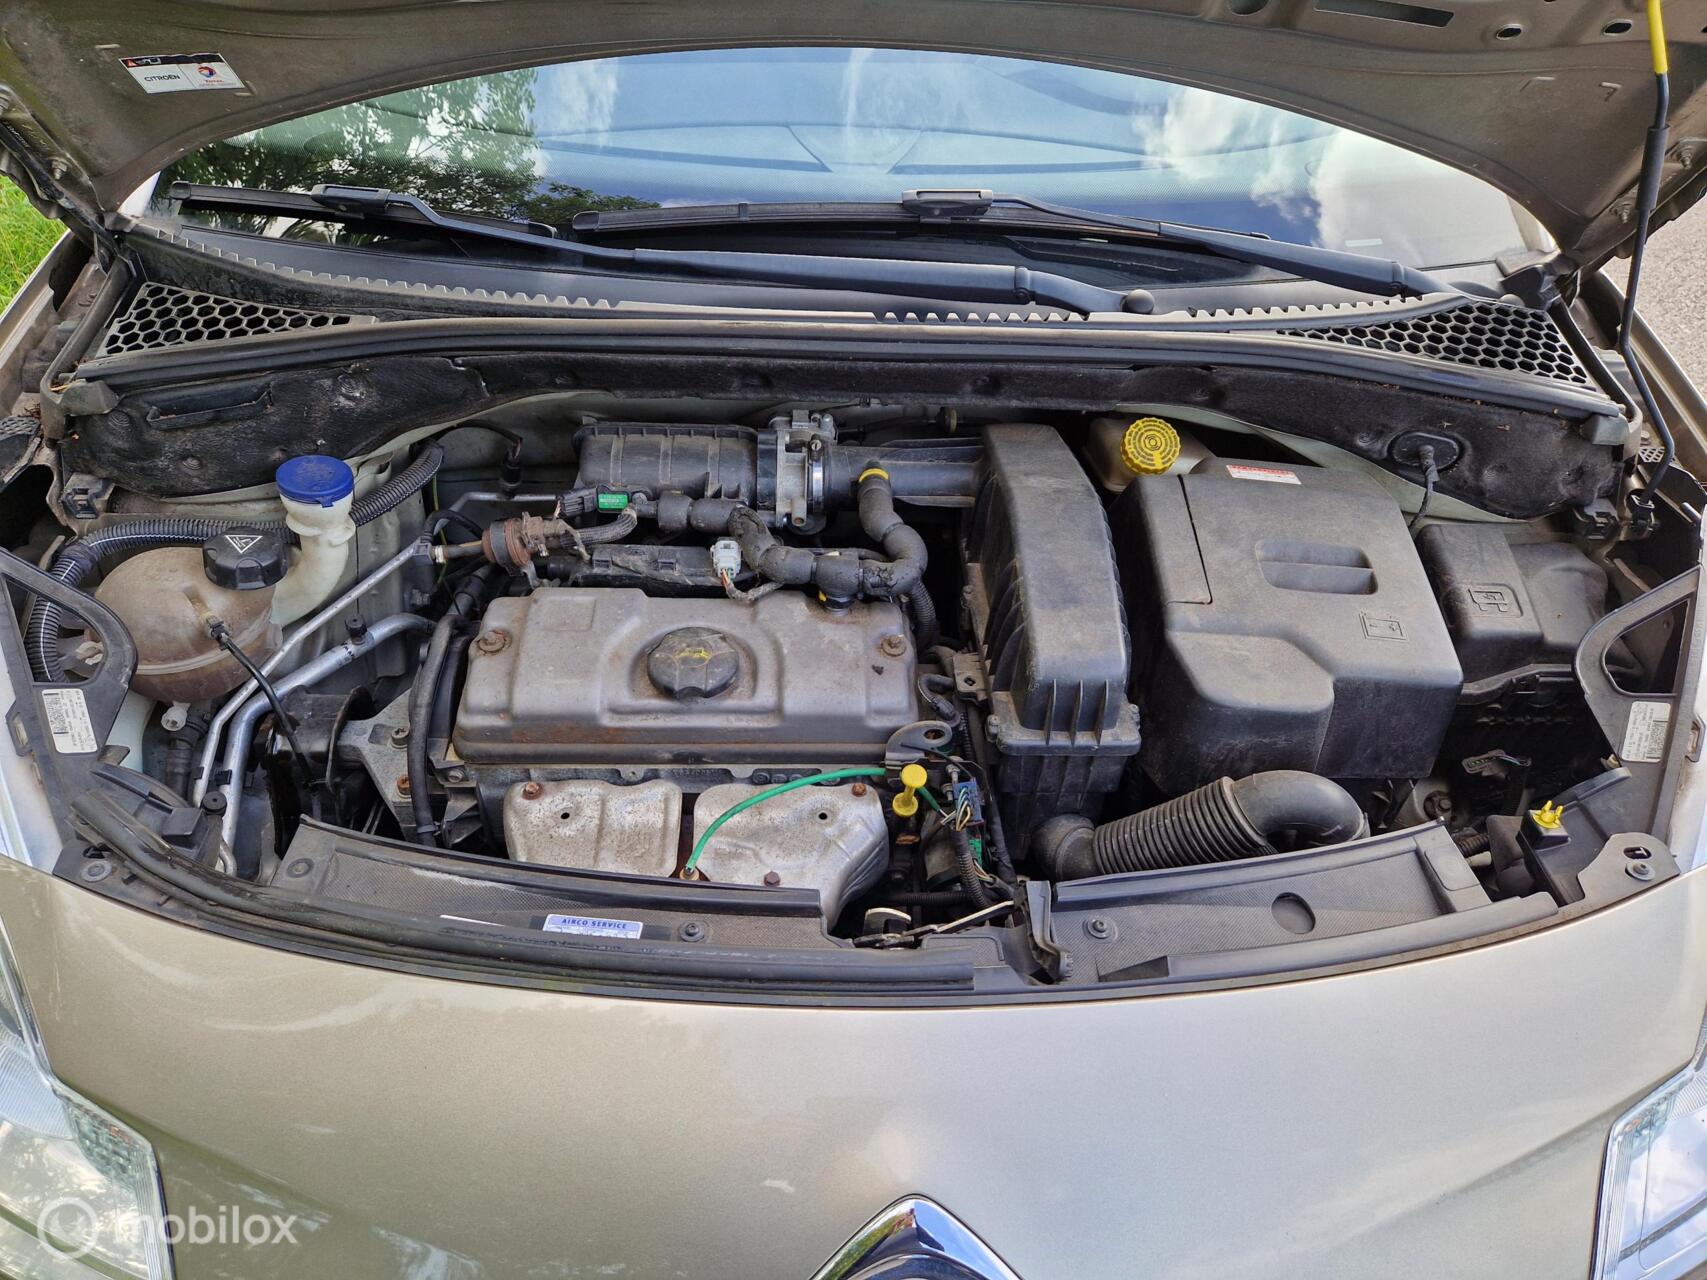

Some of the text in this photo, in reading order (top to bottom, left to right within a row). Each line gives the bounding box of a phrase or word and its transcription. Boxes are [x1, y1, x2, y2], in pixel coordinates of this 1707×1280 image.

[144, 73, 181, 82] CITROËN
[561, 918, 627, 929] AIRCO SERVICE
